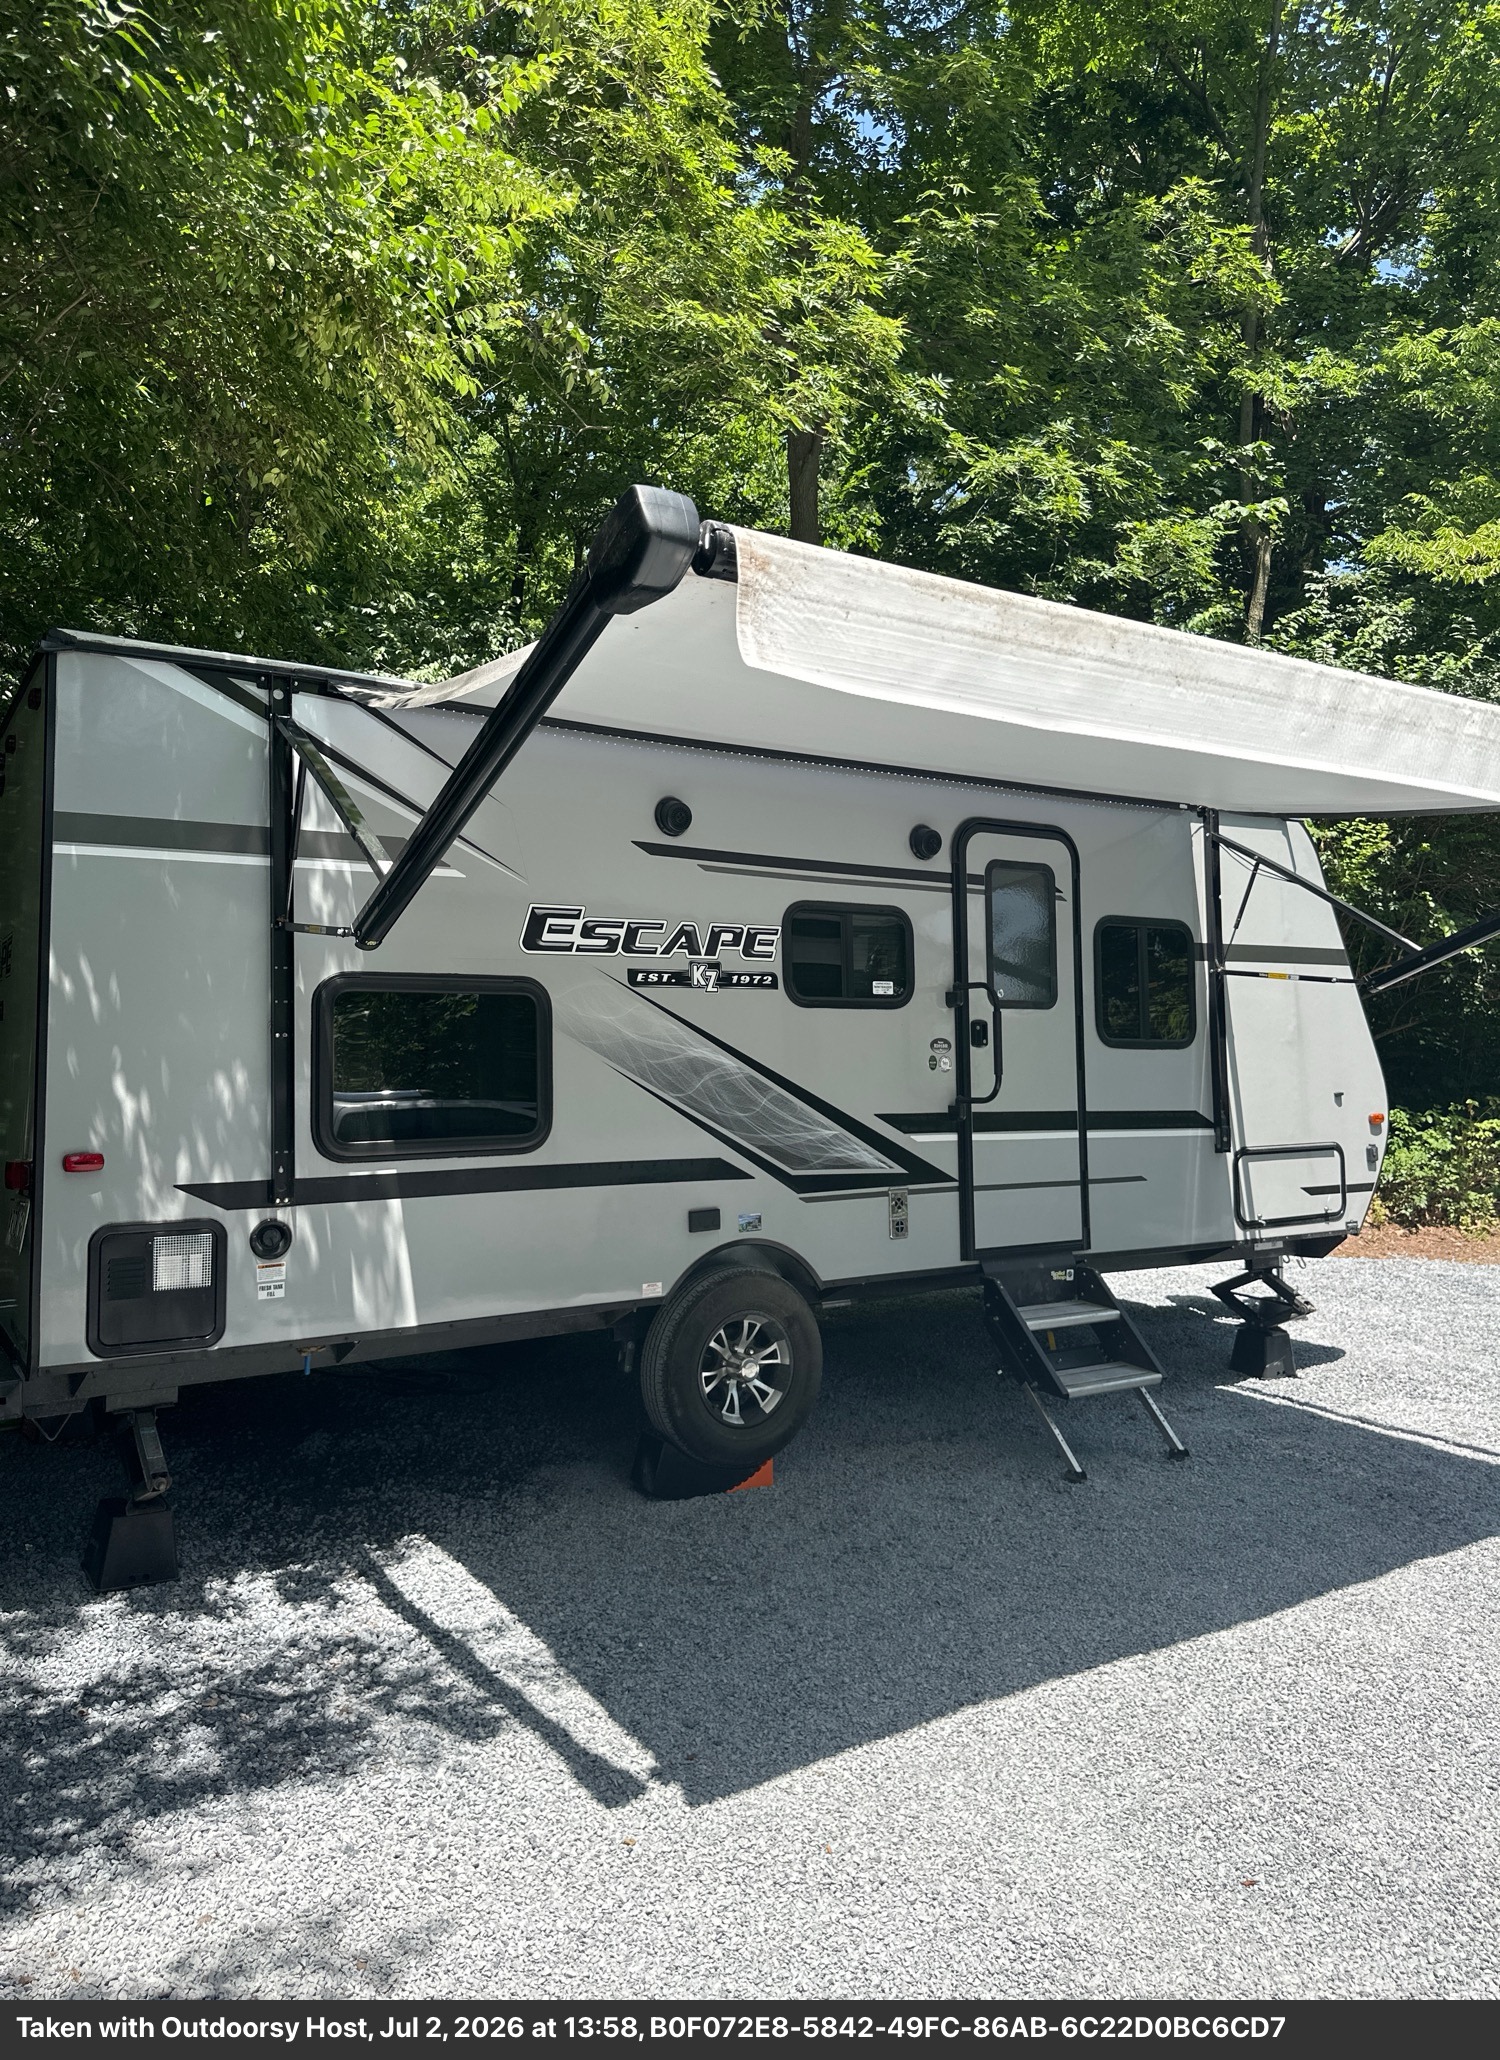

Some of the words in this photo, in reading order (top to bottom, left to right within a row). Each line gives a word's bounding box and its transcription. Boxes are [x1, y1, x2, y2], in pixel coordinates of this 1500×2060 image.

[519, 903, 781, 962] ESCAPE
[636, 972, 677, 984] EST.
[691, 962, 719, 993] KZ
[730, 974, 773, 986] 1972
